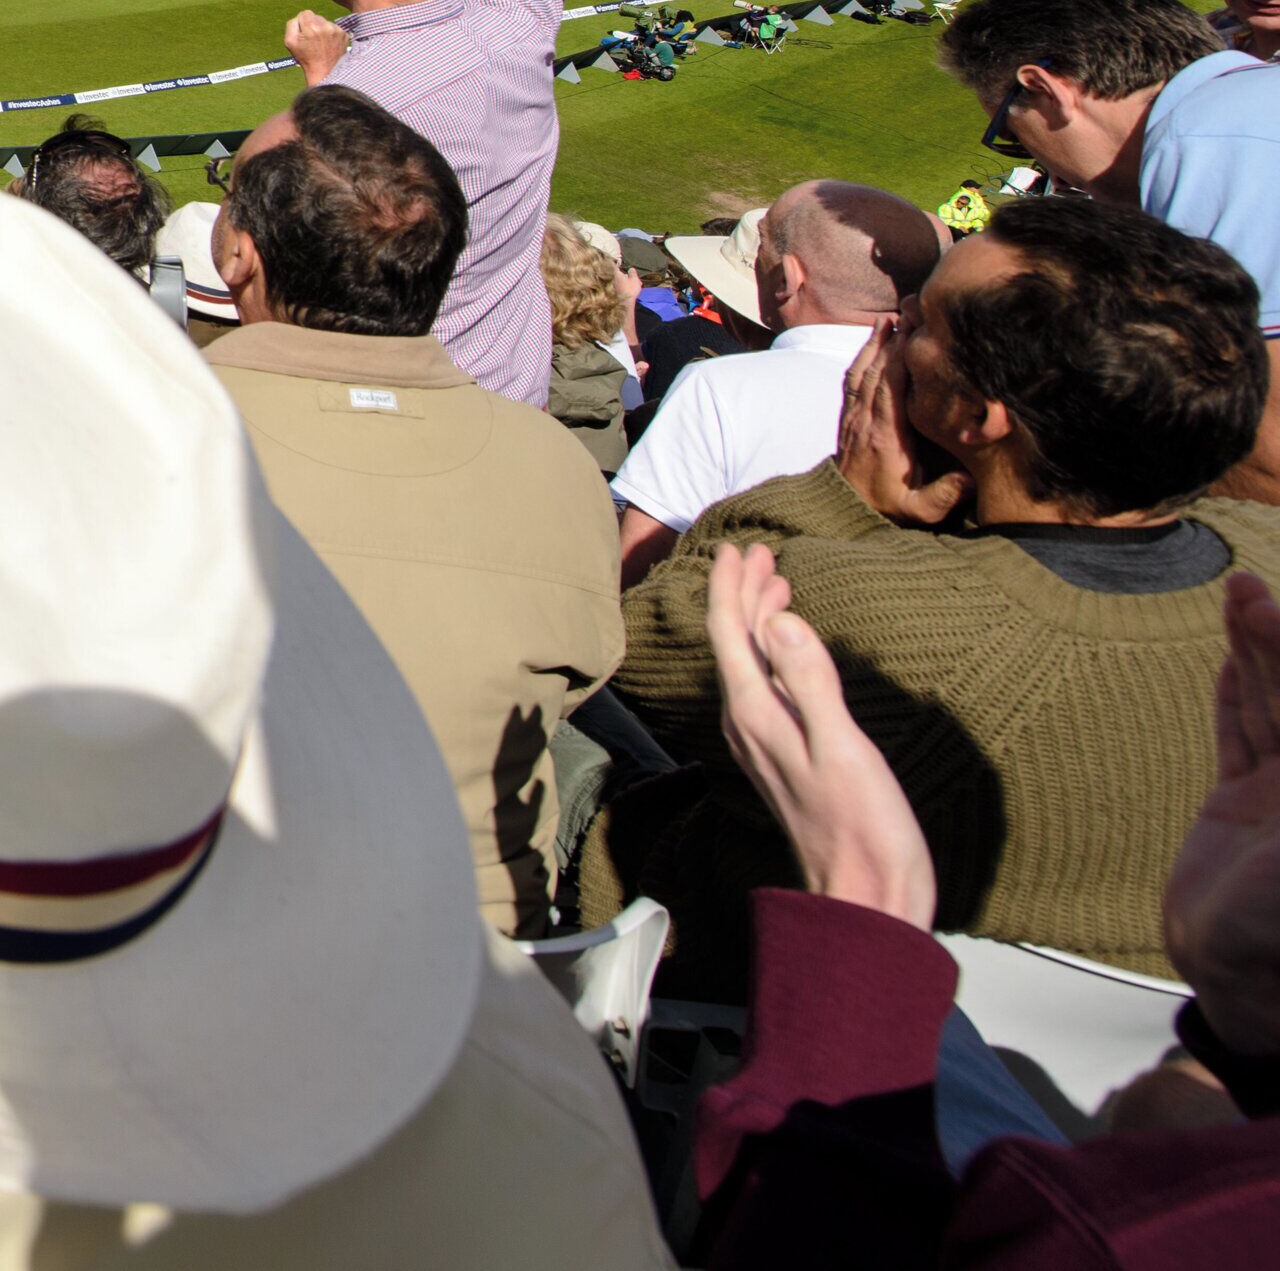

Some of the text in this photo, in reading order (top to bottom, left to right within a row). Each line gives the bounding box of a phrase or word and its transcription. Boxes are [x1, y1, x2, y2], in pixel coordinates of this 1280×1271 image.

[182, 77, 209, 87] Investec
[117, 86, 144, 97] Investec
[150, 83, 176, 92] Investec
[82, 91, 109, 101] Investec
